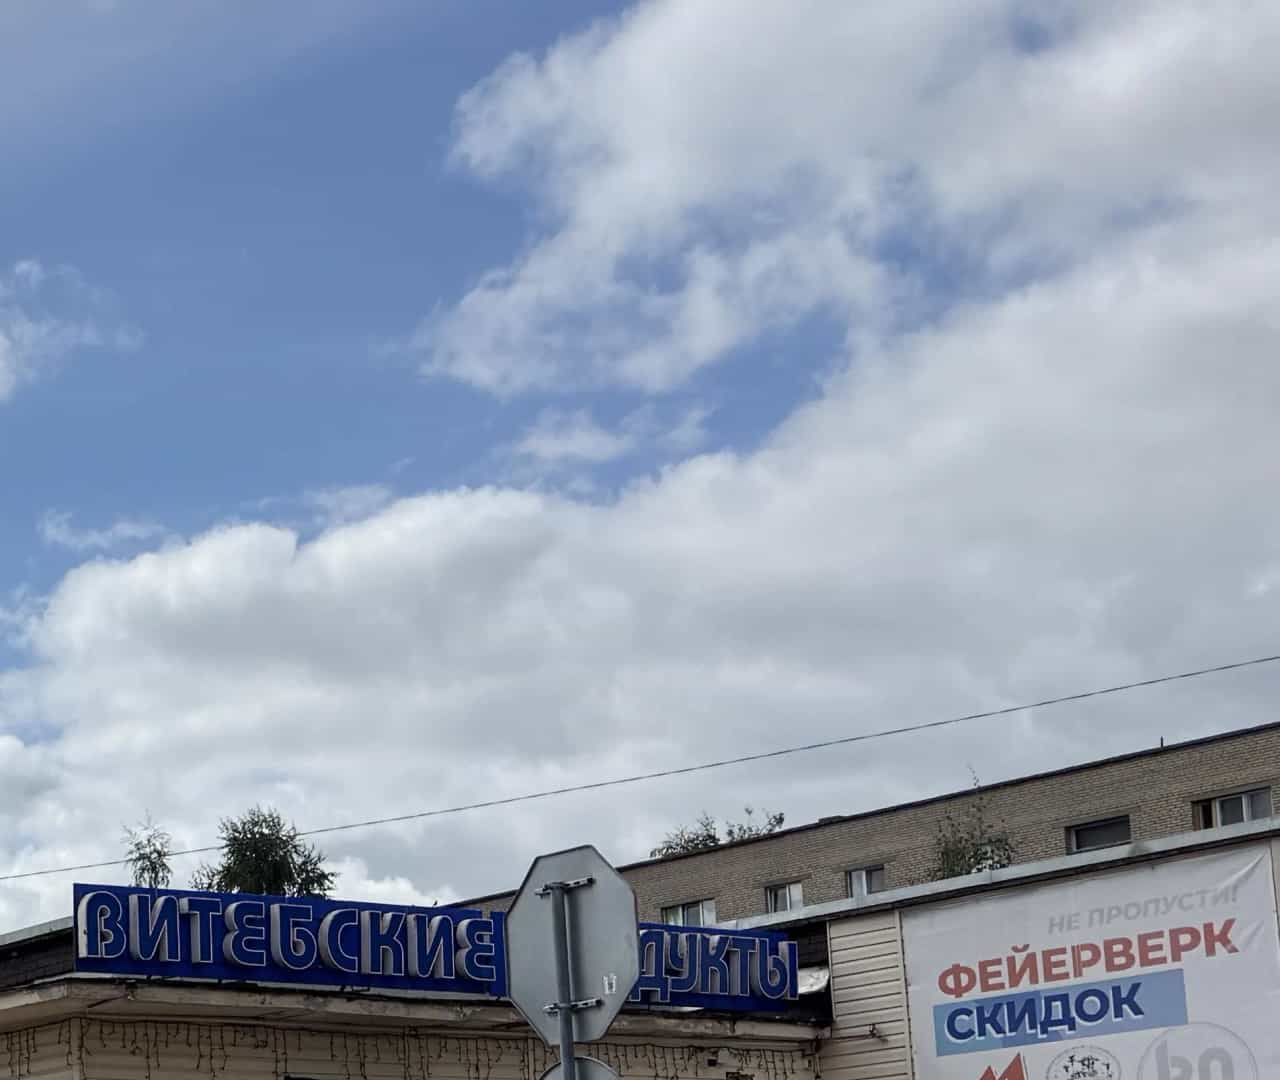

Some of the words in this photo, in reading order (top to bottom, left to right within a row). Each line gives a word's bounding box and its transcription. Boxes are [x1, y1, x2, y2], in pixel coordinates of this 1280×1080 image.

[78, 890, 497, 982] ВИТЕБСКИЕ
[628, 929, 799, 1003] ДУКТЫ
[938, 918, 1239, 998] ФЕЙЕРВЕРК
[1048, 912, 1080, 935] НЕ
[945, 982, 1145, 1041] СКИДОК
